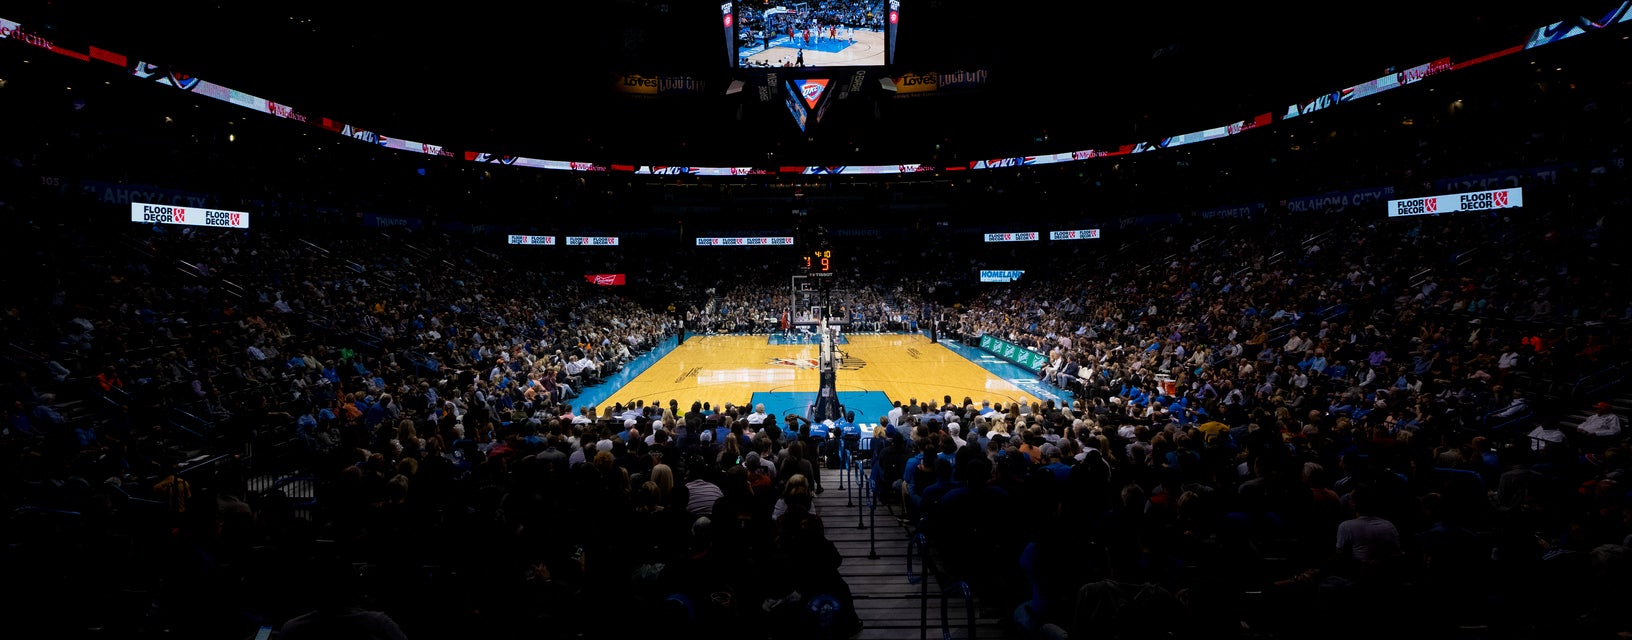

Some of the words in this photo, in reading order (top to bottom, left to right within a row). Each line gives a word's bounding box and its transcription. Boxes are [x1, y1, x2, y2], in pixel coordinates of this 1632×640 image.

[0, 24, 53, 50] edicine
[1460, 192, 1493, 203] FLOOR
[1397, 199, 1425, 209] FLOOR
[1460, 200, 1493, 210] DECOR
[143, 205, 173, 215] FLOOR
[205, 210, 230, 220] FLOOR
[1397, 206, 1425, 215] DECOR
[143, 213, 173, 223] DECOR
[205, 217, 230, 226] DECOR
[821, 257, 829, 271] 9
